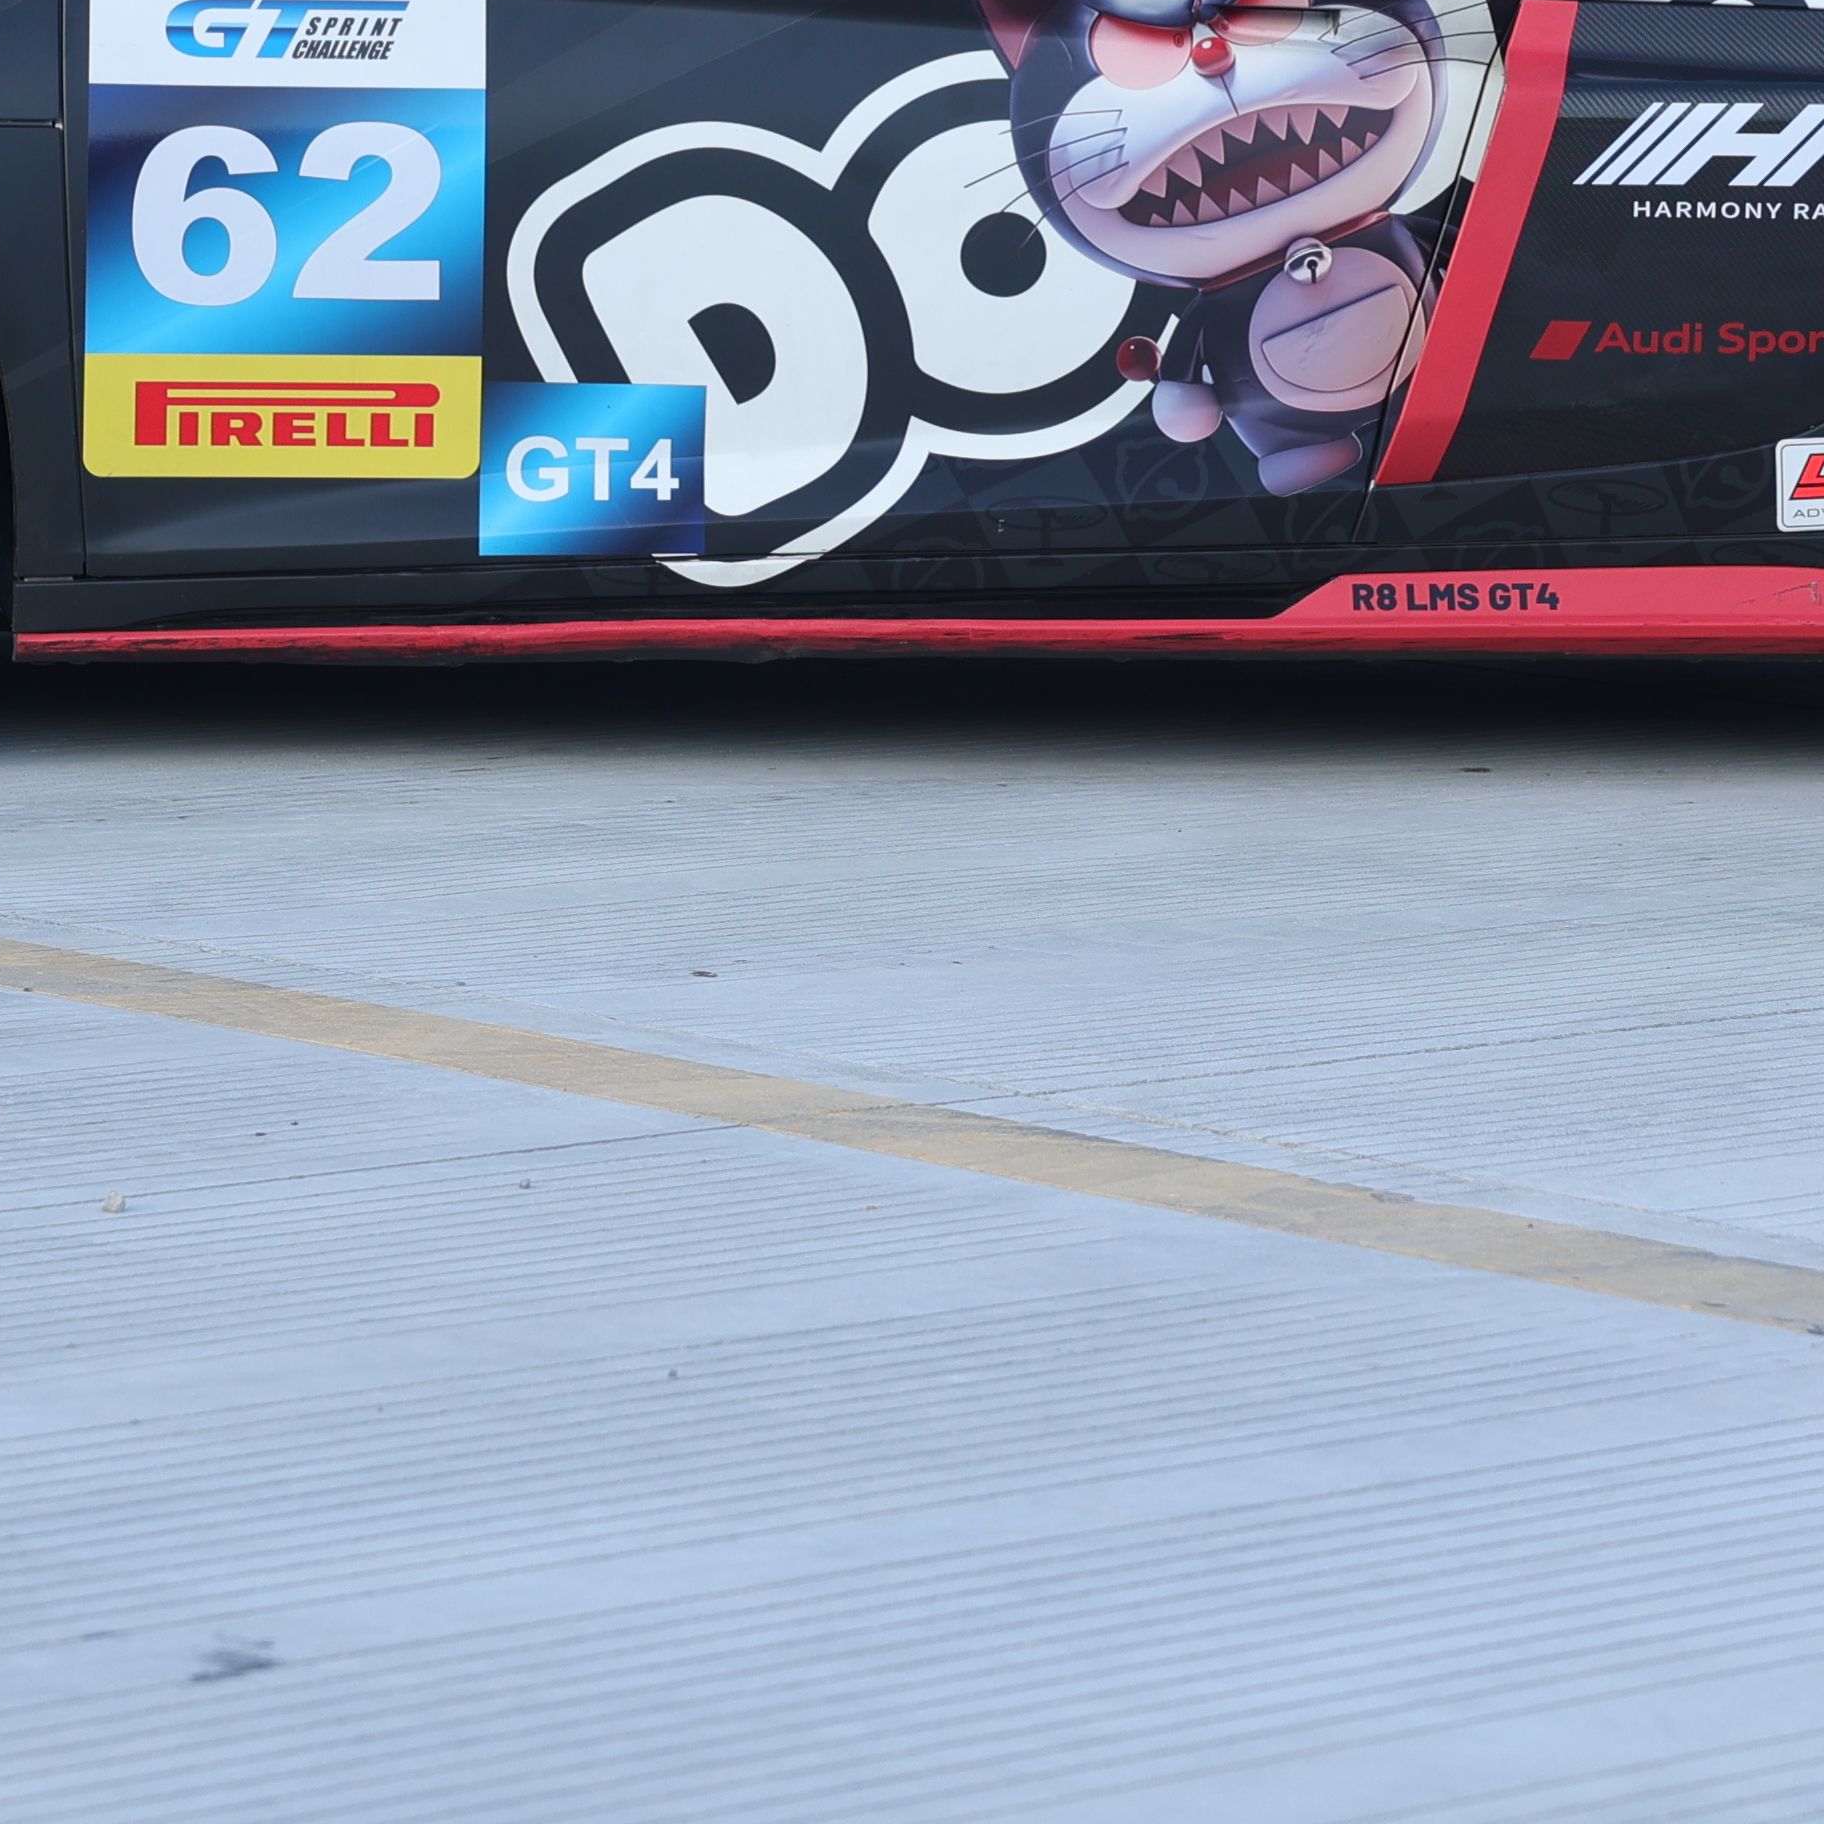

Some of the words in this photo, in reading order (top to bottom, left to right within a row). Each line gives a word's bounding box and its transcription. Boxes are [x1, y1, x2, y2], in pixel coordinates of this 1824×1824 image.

[305, 16, 403, 38] SPRINT
[292, 39, 395, 61] CHALLENGE
[131, 121, 441, 307] 62
[1633, 201, 1782, 220] HARMONY
[1594, 322, 1703, 354] Audi
[134, 381, 440, 449] PIRELLI
[505, 435, 680, 503] GT4
[1352, 582, 1398, 612] R8
[1406, 582, 1479, 612] LMS
[1488, 582, 1560, 612] GT4
